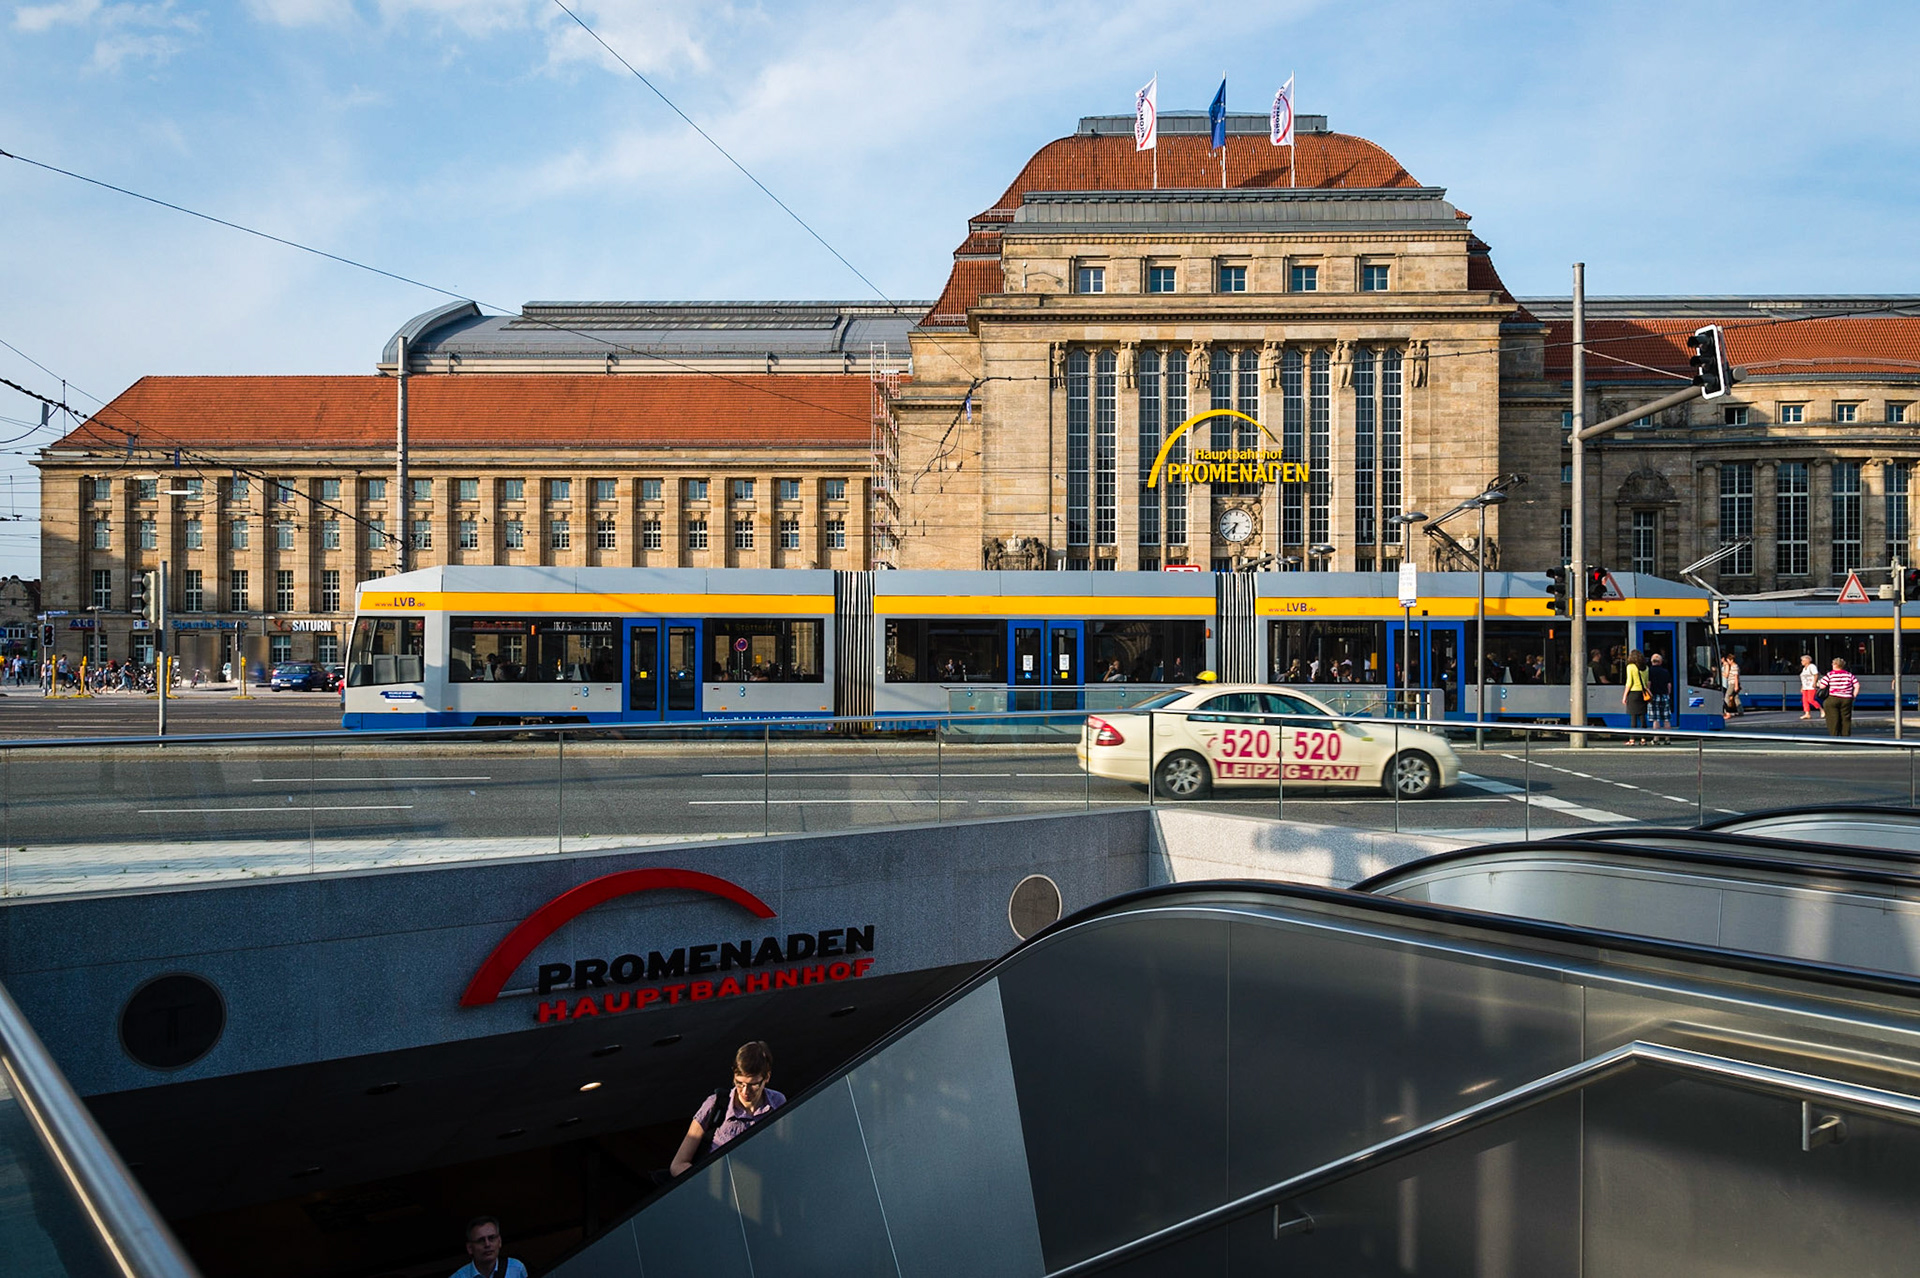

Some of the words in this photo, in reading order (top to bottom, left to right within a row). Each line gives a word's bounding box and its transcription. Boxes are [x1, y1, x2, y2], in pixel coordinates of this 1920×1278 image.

[1195, 448, 1283, 462] Hauptbahnhof
[1167, 462, 1310, 483] PROMENADEN
[292, 620, 332, 631] SATURN
[538, 925, 875, 995] PROMENADEN
[537, 957, 876, 1024] HAUPTBAHNHOF
